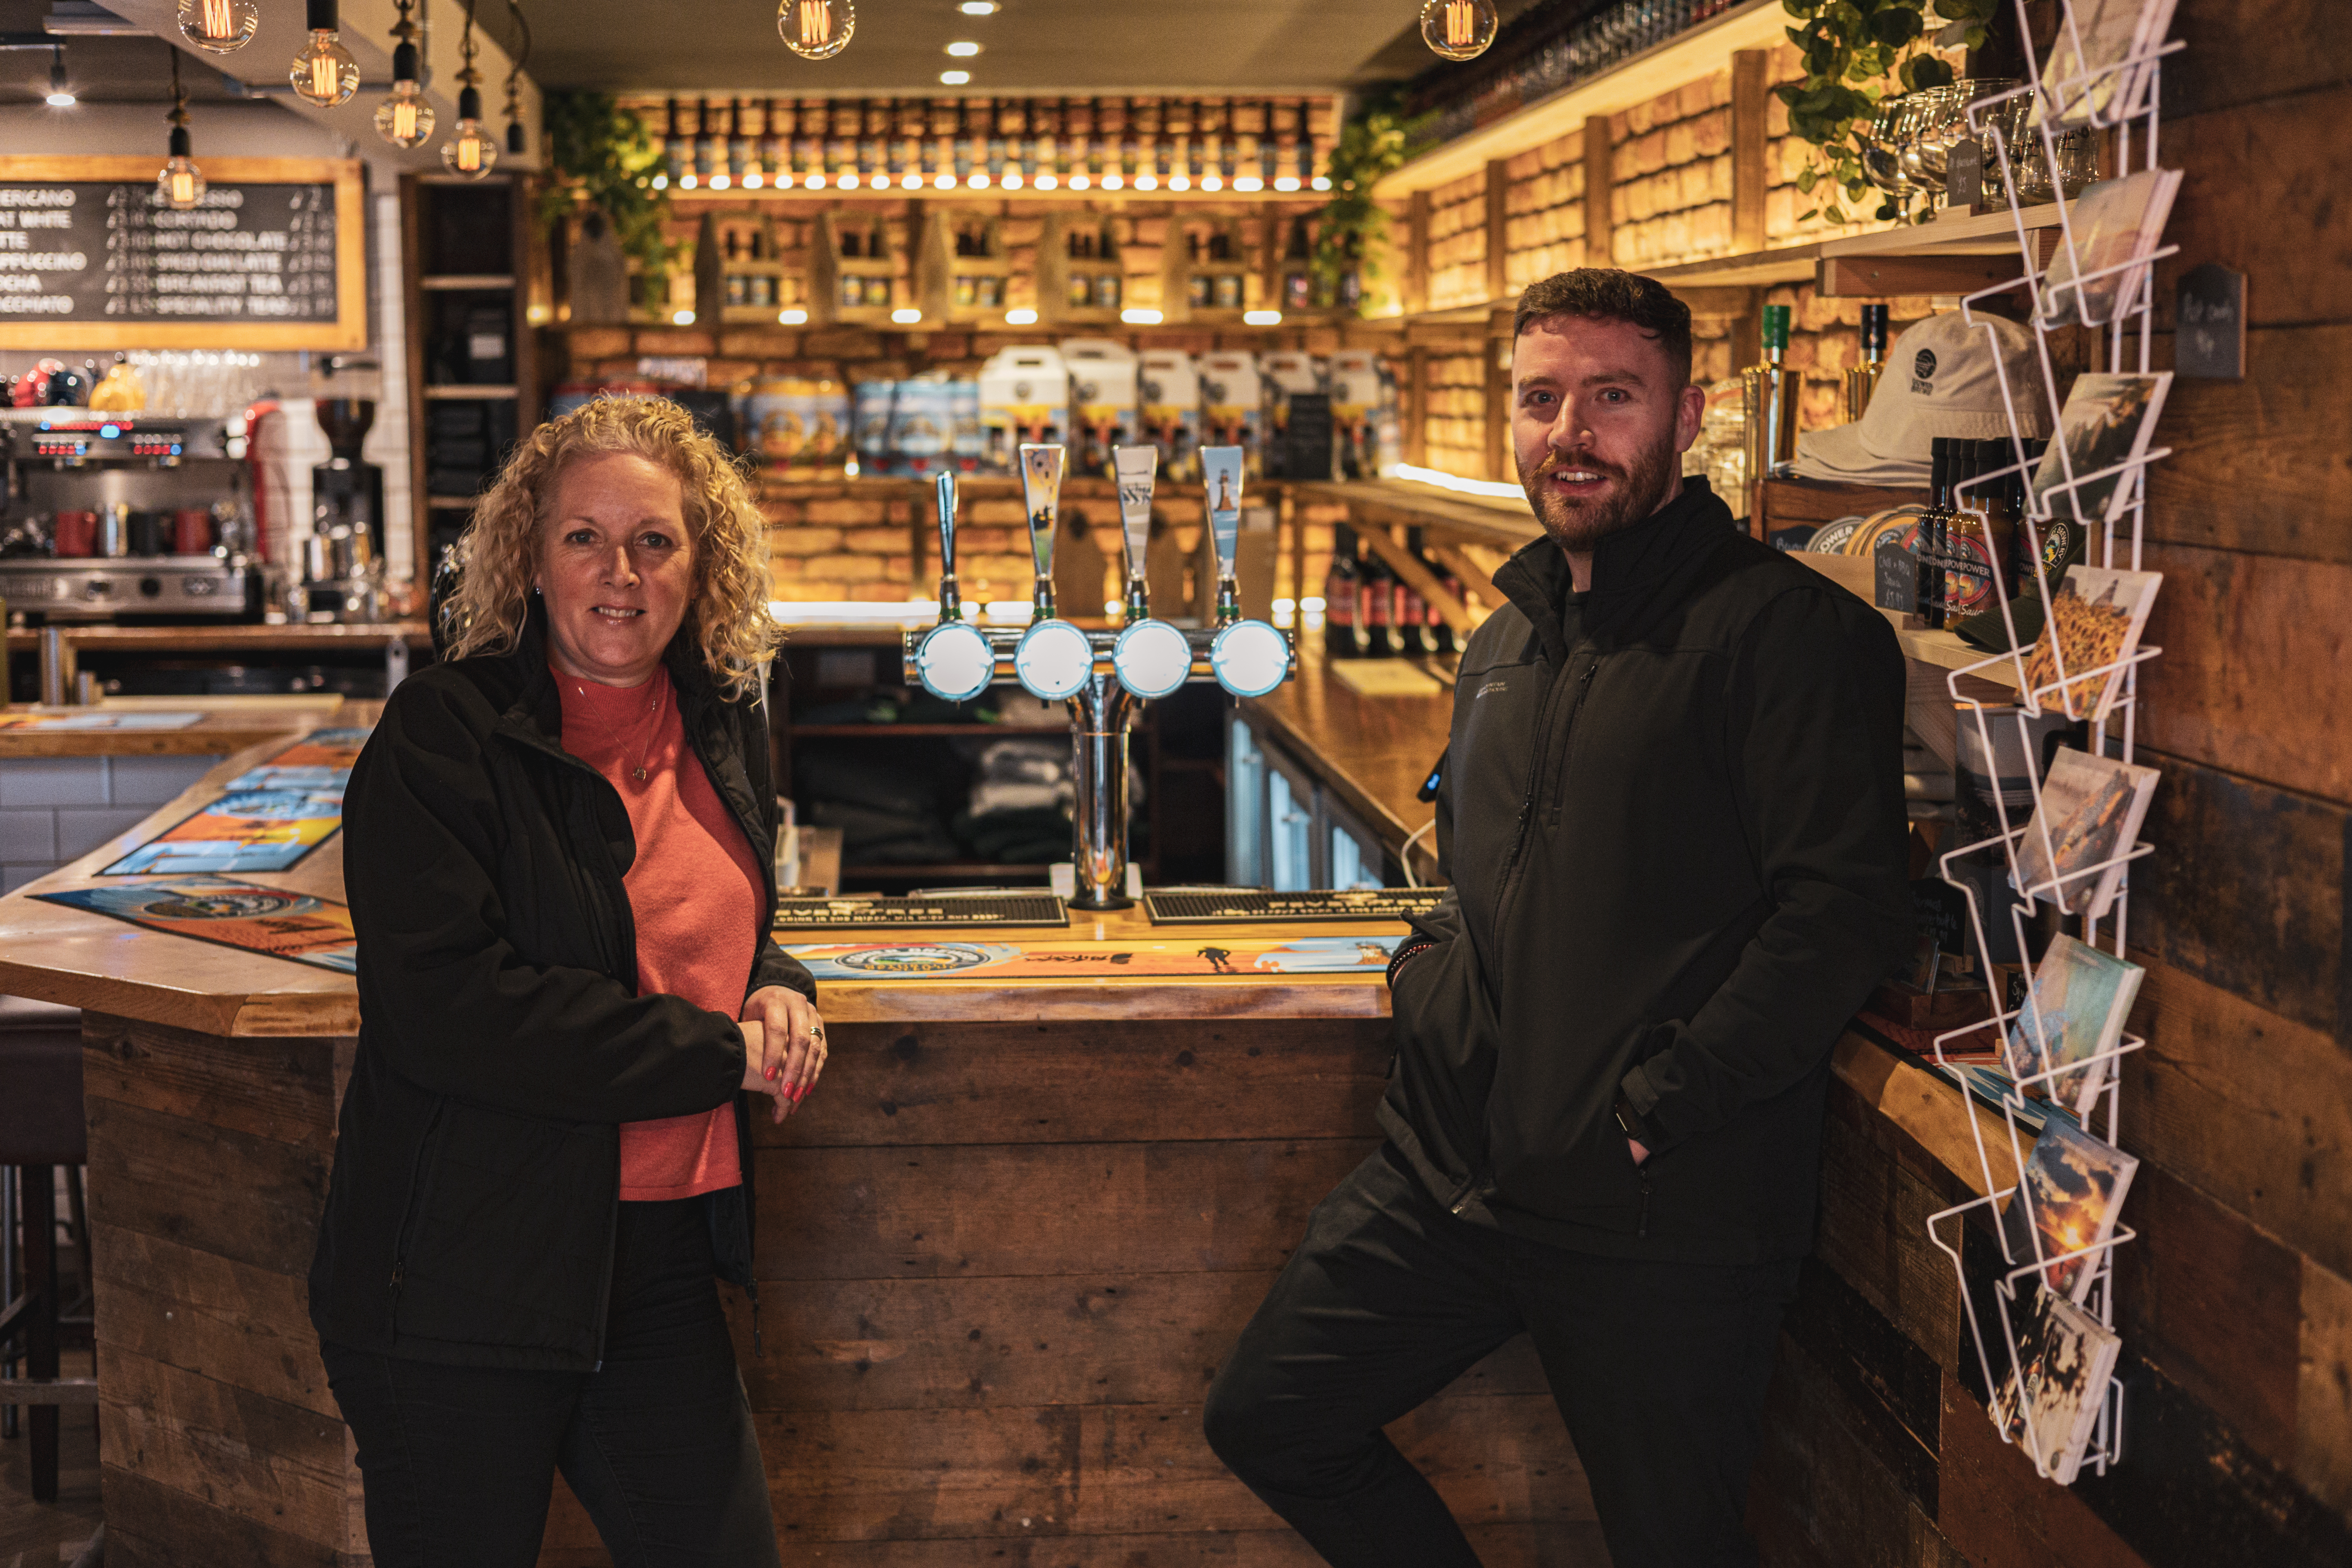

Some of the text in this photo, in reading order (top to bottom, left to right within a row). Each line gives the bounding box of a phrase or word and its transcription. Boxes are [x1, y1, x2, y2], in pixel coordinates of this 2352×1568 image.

[19, 210, 72, 228] WHITE
[154, 231, 189, 250] HOT
[190, 231, 288, 251] CHOCOLATE
[234, 252, 283, 273] LATTE
[156, 273, 247, 293] BREAKFAST
[250, 274, 284, 294] TEA
[247, 296, 291, 315] TEAS
[1817, 526, 1853, 553] OWER
[2057, 526, 2067, 559] BREWERY
[1963, 563, 1990, 577] POWER
